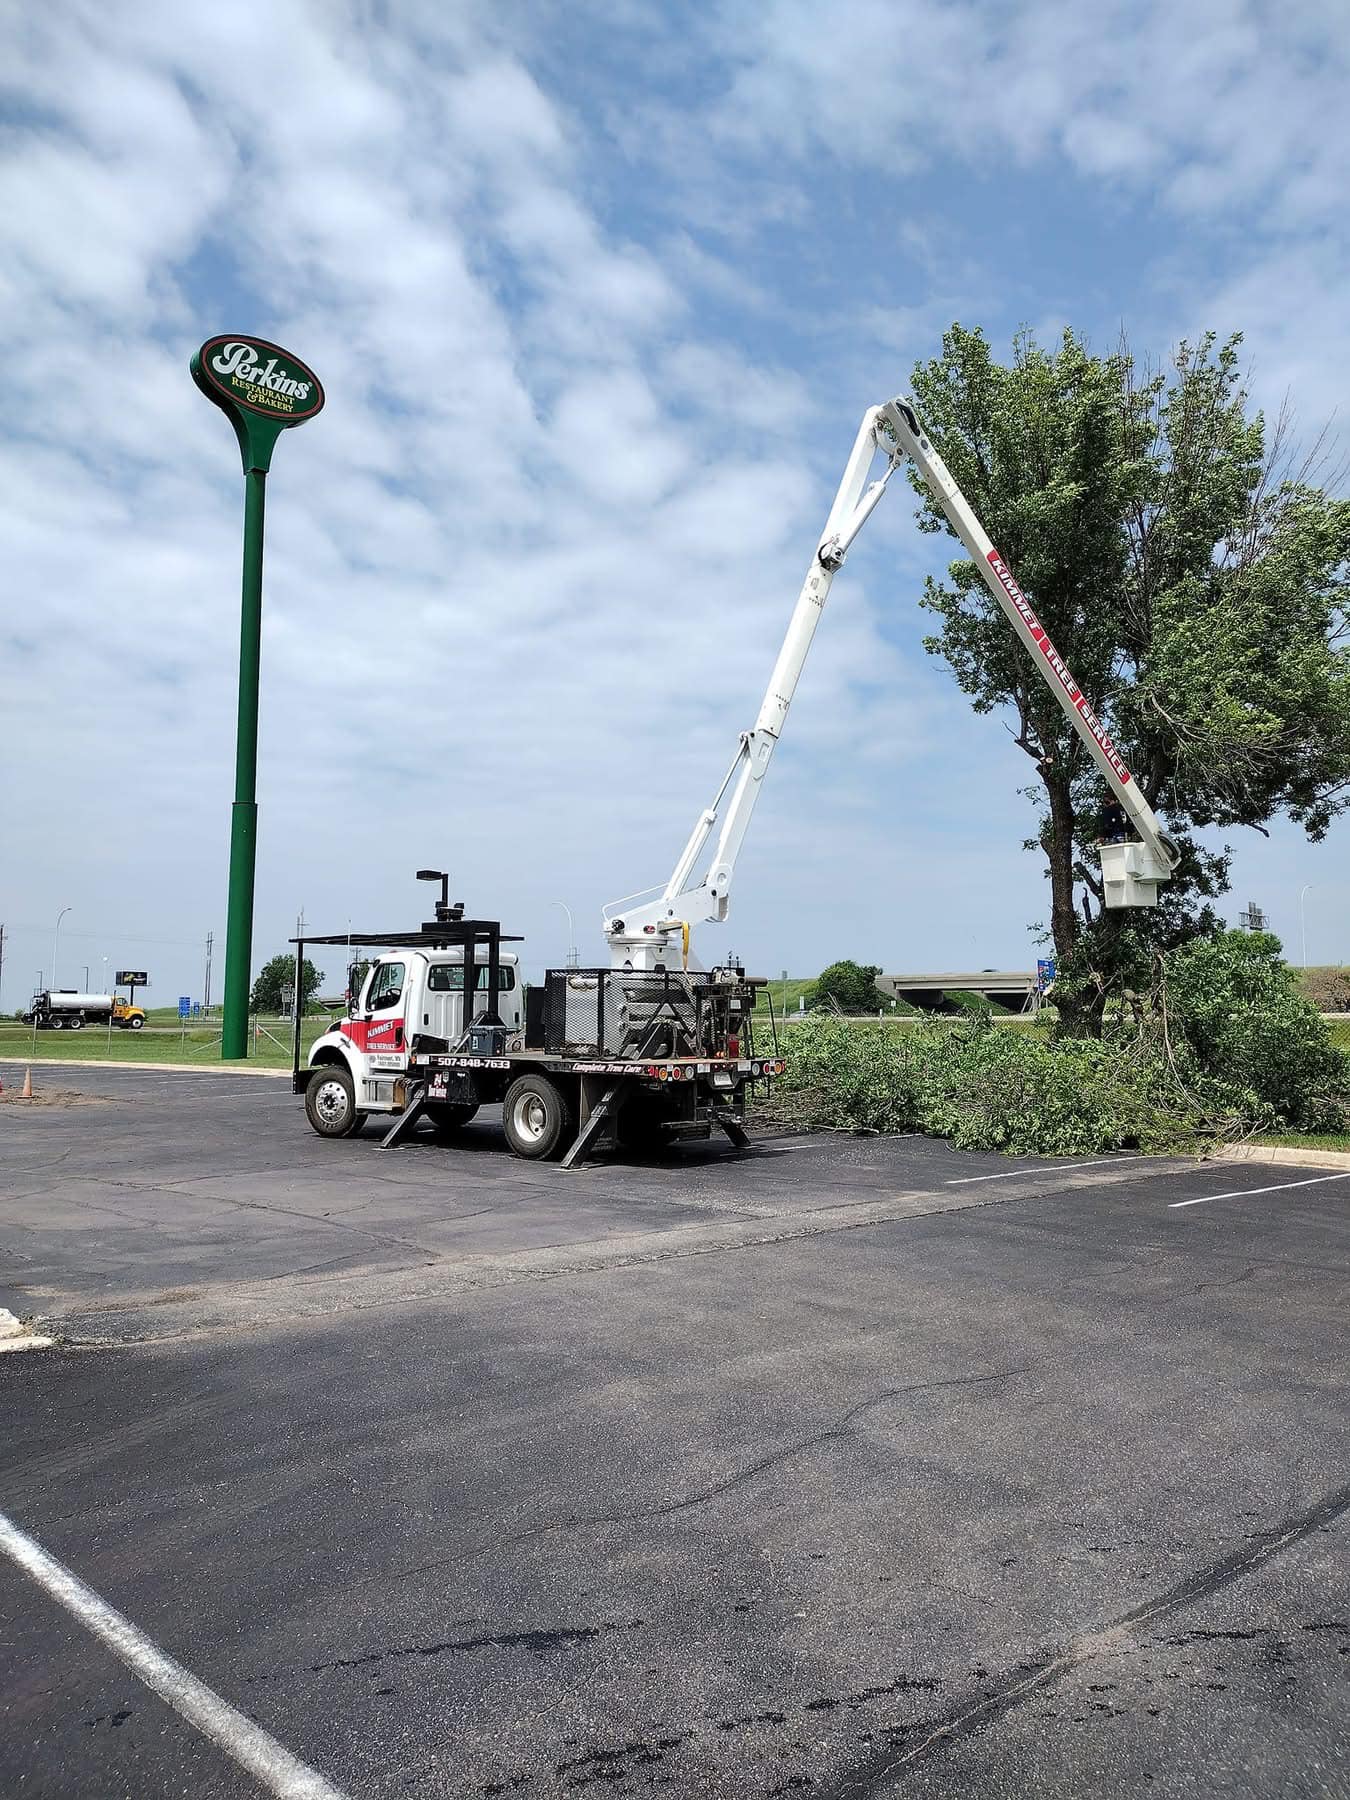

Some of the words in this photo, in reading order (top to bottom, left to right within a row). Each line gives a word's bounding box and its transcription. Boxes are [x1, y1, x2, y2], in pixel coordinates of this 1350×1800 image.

[212, 342, 310, 400] Perkins
[231, 376, 295, 405] RESTAURANT
[258, 394, 294, 413] BAKERY
[991, 559, 1041, 630] KIMMET
[1046, 645, 1078, 696] TREE
[1080, 704, 1128, 778] SERVICE
[367, 1020, 394, 1039] KIMMET
[438, 1057, 511, 1069] 507-848-7633
[572, 1062, 606, 1073] Complete
